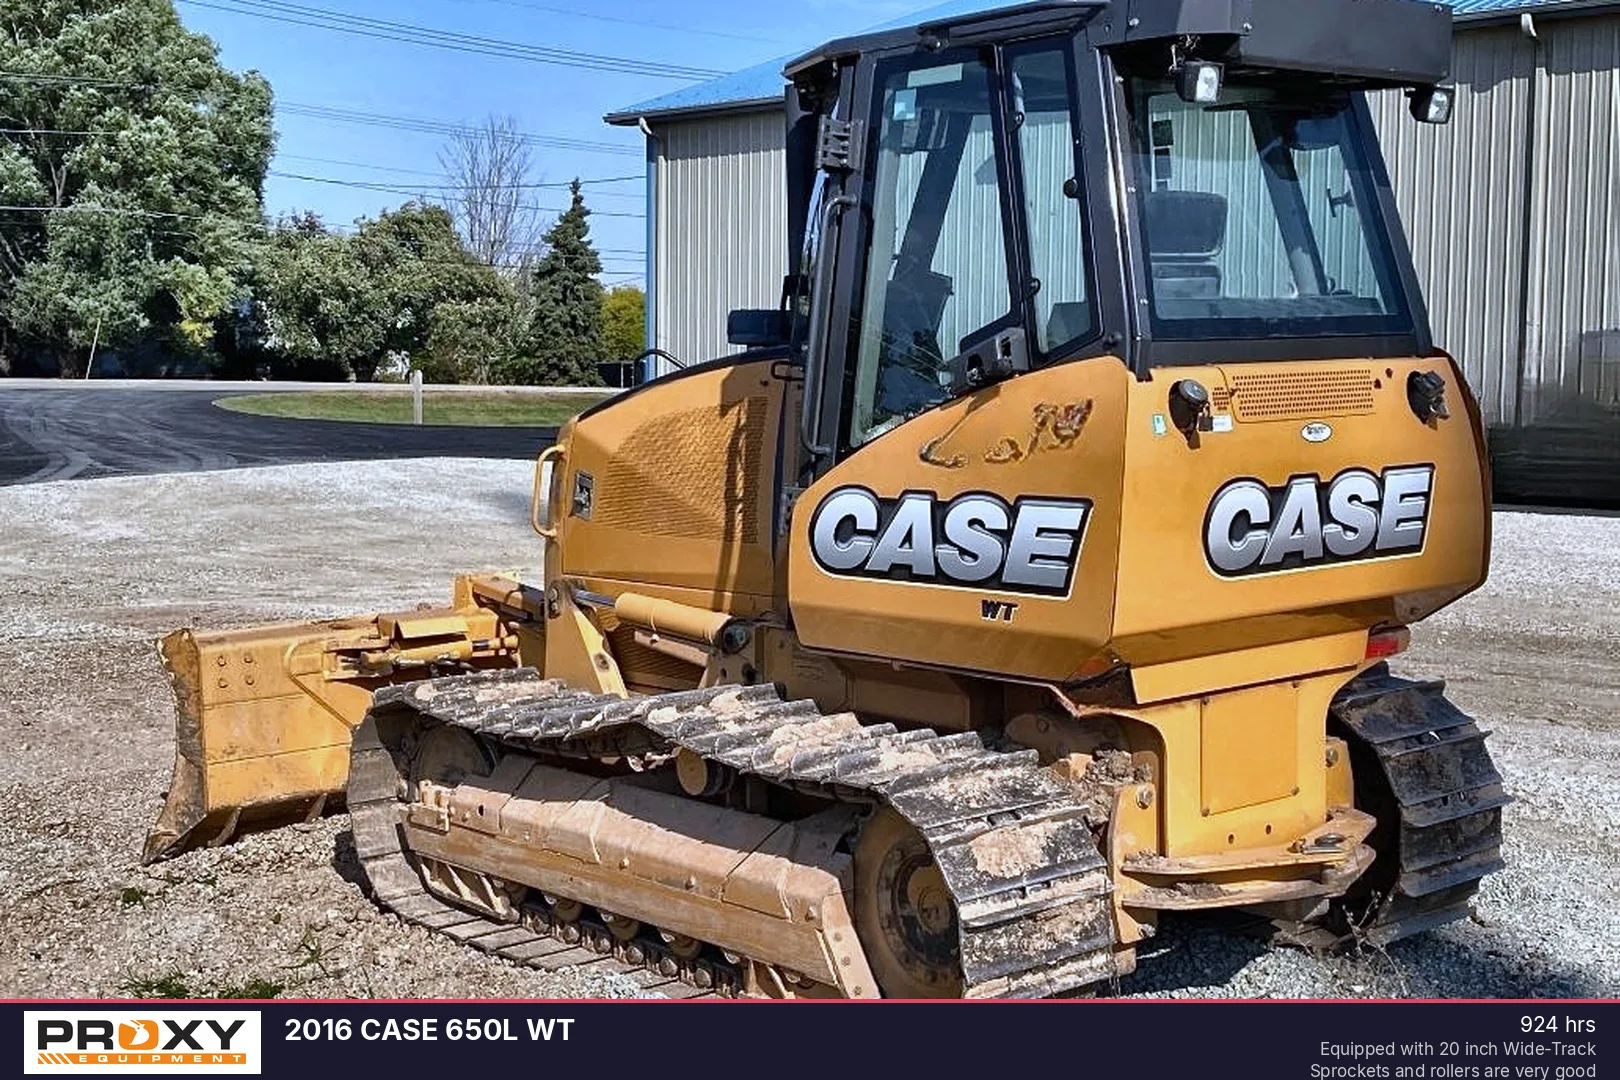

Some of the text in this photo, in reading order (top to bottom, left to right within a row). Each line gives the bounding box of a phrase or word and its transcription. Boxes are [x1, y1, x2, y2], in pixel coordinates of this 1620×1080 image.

[811, 486, 1087, 590] CASE
[1206, 466, 1434, 572] CASE
[981, 599, 1018, 621] WT
